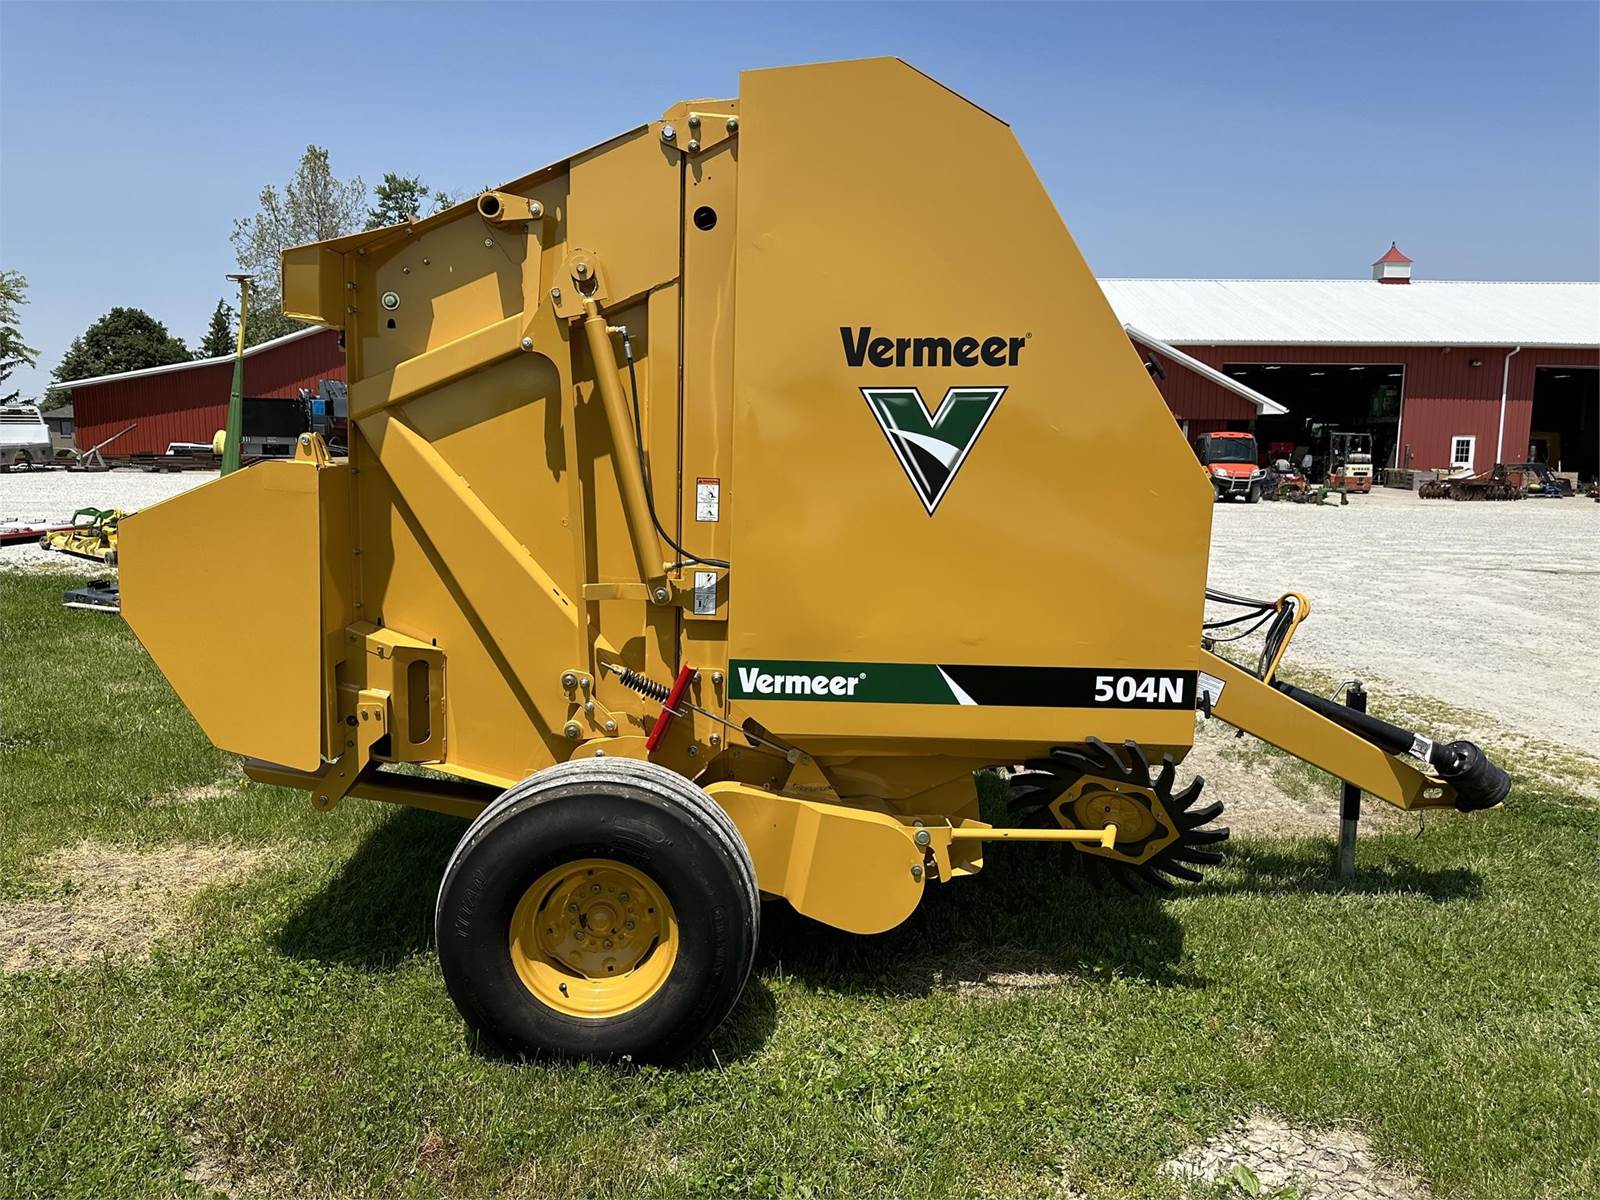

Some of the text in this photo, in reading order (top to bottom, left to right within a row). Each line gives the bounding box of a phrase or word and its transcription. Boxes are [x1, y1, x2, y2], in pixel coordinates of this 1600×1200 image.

[840, 326, 1026, 368] Vermeer
[738, 667, 859, 696] Vermeer
[1094, 675, 1184, 703] 504N
